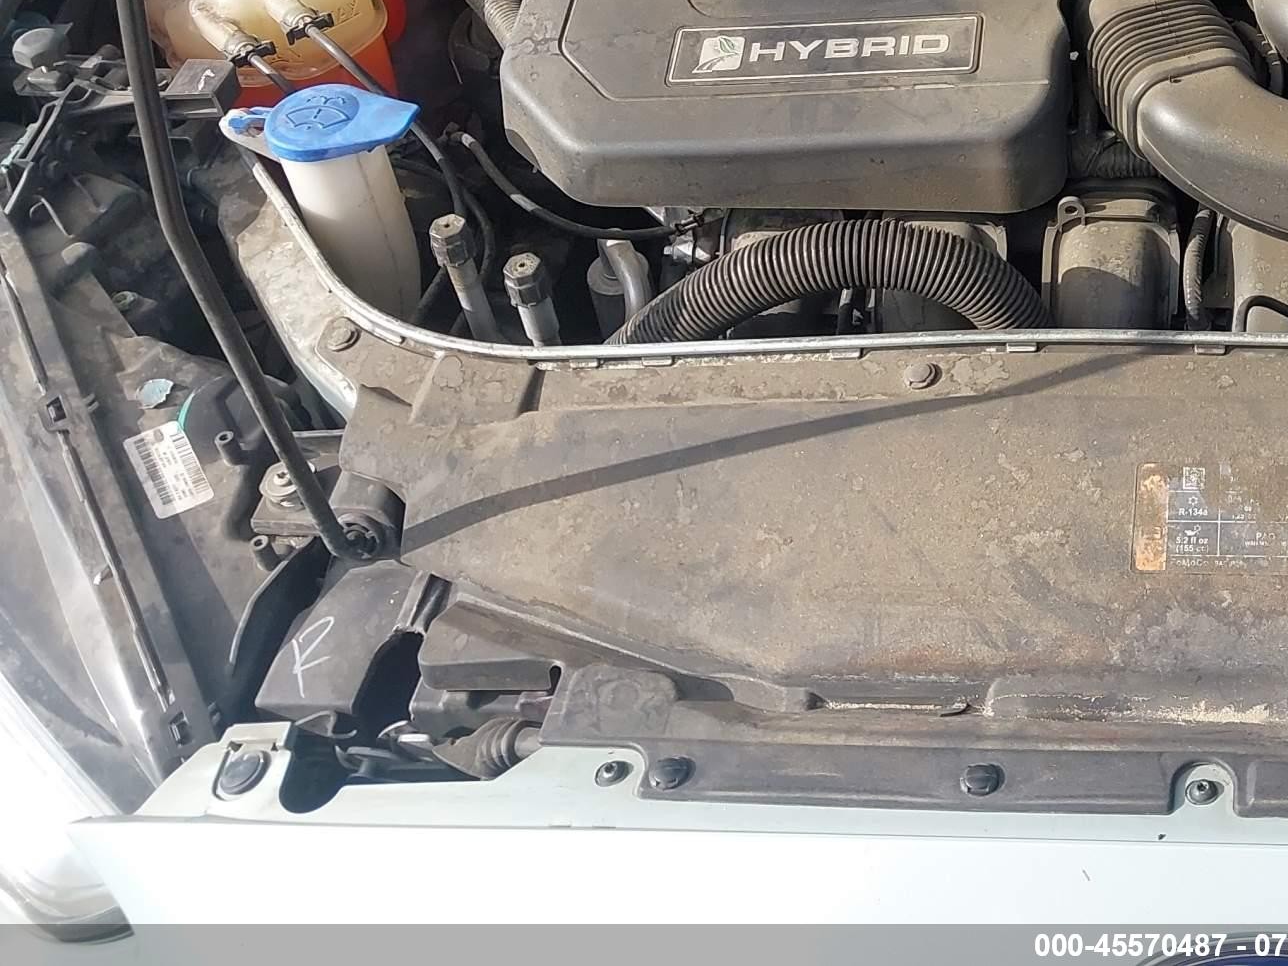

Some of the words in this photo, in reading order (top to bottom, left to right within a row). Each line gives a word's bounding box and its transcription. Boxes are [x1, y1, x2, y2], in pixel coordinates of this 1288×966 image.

[749, 34, 950, 62] HYBRID
[1178, 508, 1208, 517] R-134a
[1175, 536, 1189, 544] 5.2
[1190, 536, 1197, 544] fl
[1176, 544, 1194, 553] (155
[291, 615, 335, 699] R
